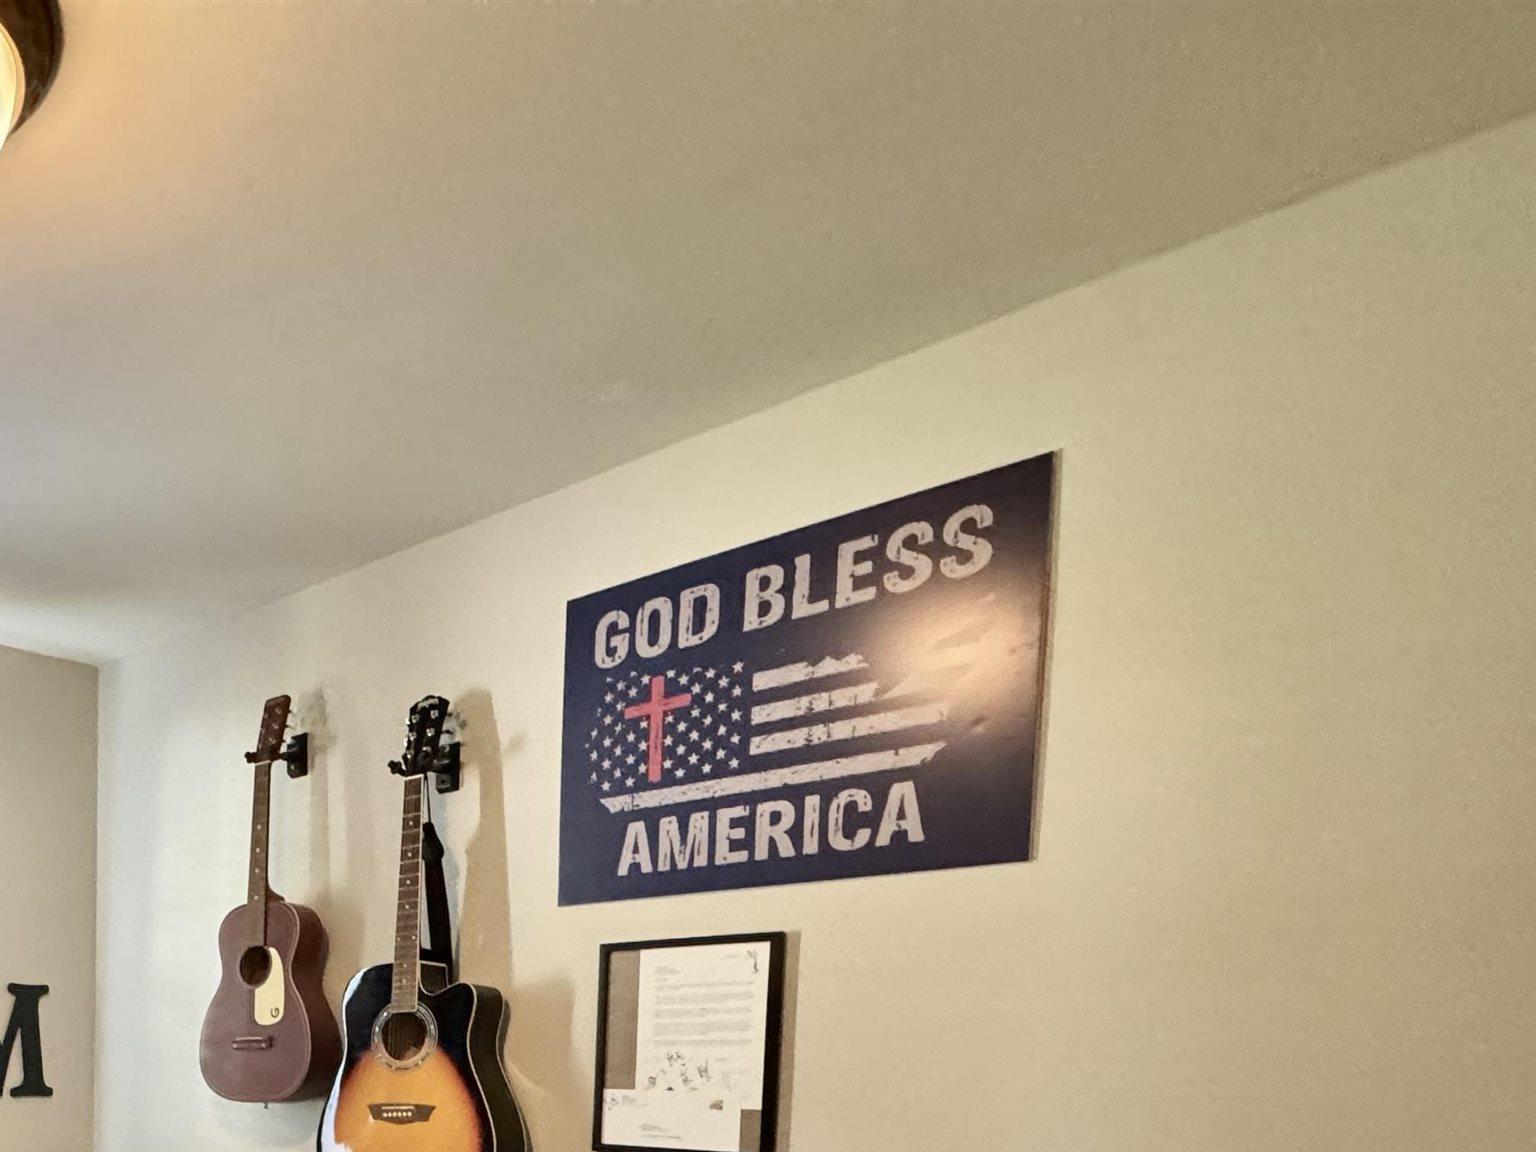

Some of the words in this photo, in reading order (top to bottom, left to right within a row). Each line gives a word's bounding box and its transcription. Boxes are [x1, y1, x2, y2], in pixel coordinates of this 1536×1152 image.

[593, 582, 721, 669] GOD
[742, 504, 995, 633] BLESS
[617, 780, 926, 876] AMERICA
